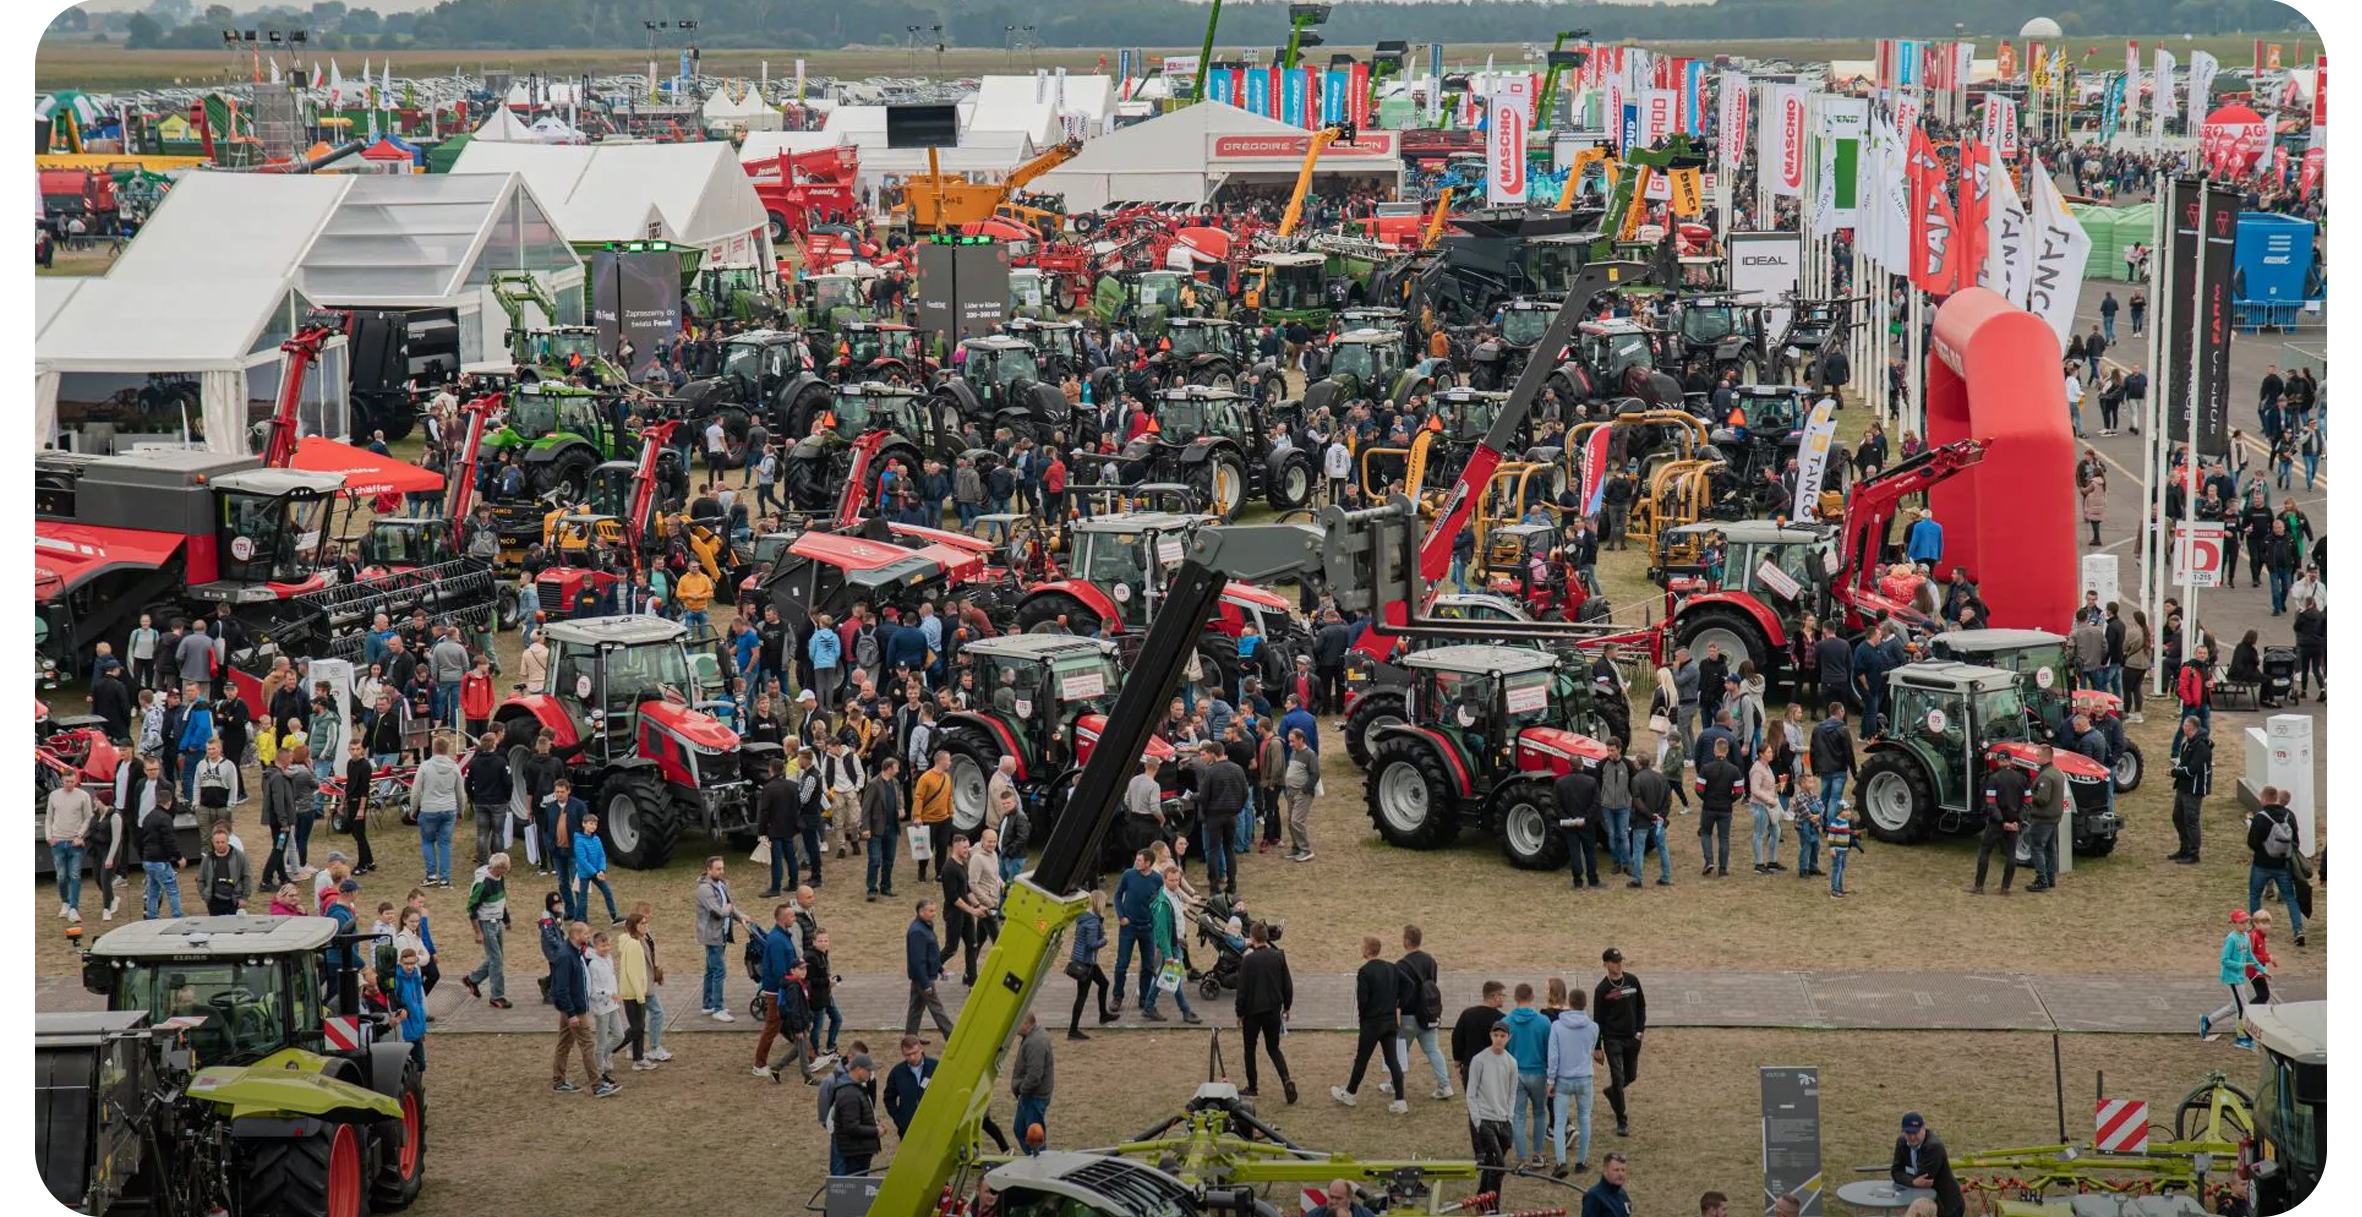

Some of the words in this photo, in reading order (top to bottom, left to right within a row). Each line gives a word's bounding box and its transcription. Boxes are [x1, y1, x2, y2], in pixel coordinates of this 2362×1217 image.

[1500, 108, 1511, 182] MASCHIO
[1783, 99, 1796, 174] MASCHIO
[1742, 255, 1788, 265] IDEAL
[2034, 225, 2071, 319] TANC
[1802, 456, 1822, 518] TANCO
[235, 543, 248, 551] 175
[2183, 540, 2219, 571] D
[2276, 750, 2287, 758] 175
